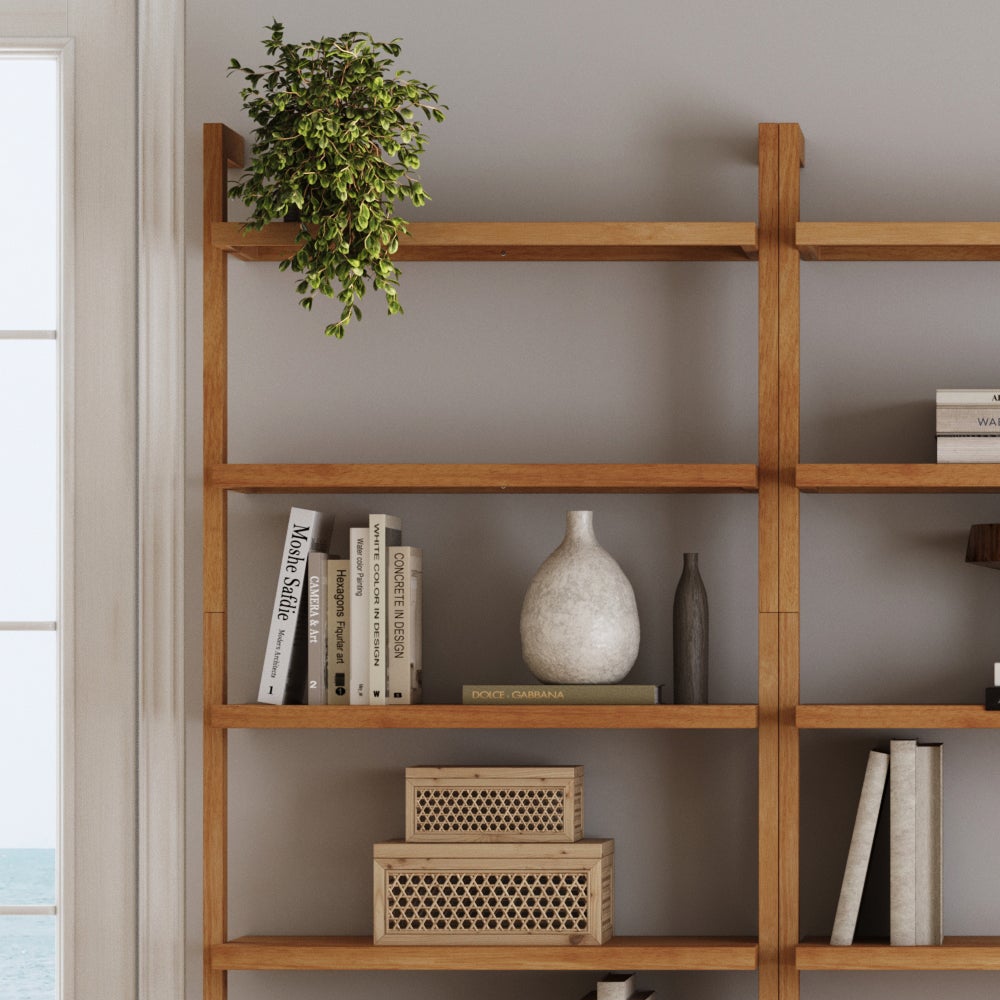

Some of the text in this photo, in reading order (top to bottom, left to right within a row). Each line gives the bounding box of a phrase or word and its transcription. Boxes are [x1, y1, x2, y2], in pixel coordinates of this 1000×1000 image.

[277, 524, 310, 621] Moshe Safdie
[355, 538, 364, 597] Water color Painting
[309, 575, 320, 618] CAMERA
[334, 569, 347, 617] Hexagons
[393, 552, 405, 659] CONCRETE IN DESIGN
[309, 628, 319, 644] Art
[309, 681, 317, 689] 2
[471, 690, 565, 699] DOLCE GABBANA
